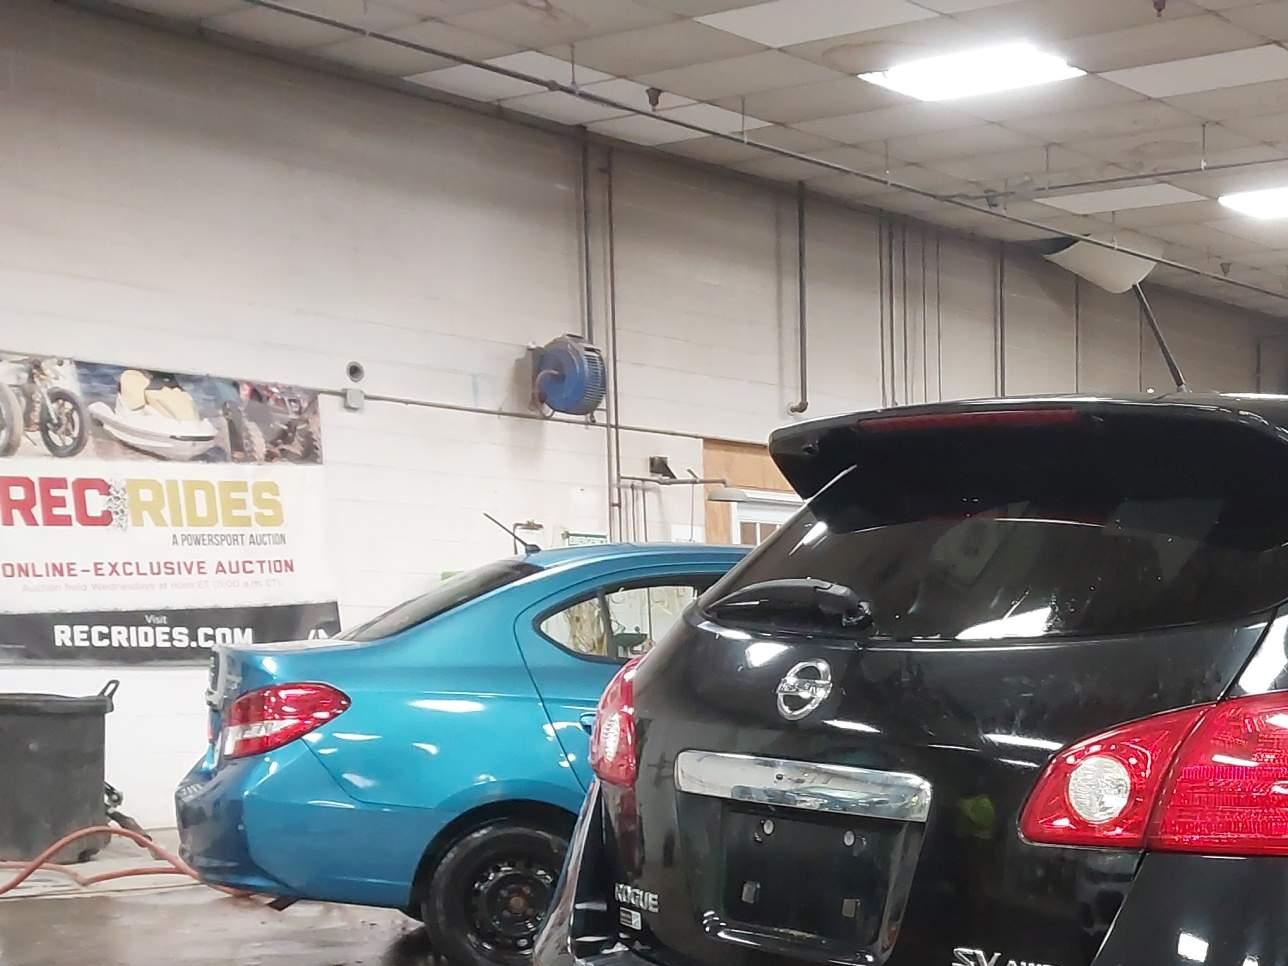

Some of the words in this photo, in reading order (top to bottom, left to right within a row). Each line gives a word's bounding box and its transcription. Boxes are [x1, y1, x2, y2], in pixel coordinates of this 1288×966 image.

[0, 476, 113, 527] REC
[127, 479, 285, 528] RIDES
[172, 533, 179, 546] A
[181, 533, 245, 546] POWERSPORT
[249, 532, 287, 545] AUCTION
[1, 560, 207, 578] ONLINE-EXCLUSIVE
[215, 559, 294, 575] AUCTION
[144, 614, 167, 625] Visit
[53, 625, 253, 648] RECRIDES.COM
[615, 883, 659, 912] ROGUE
